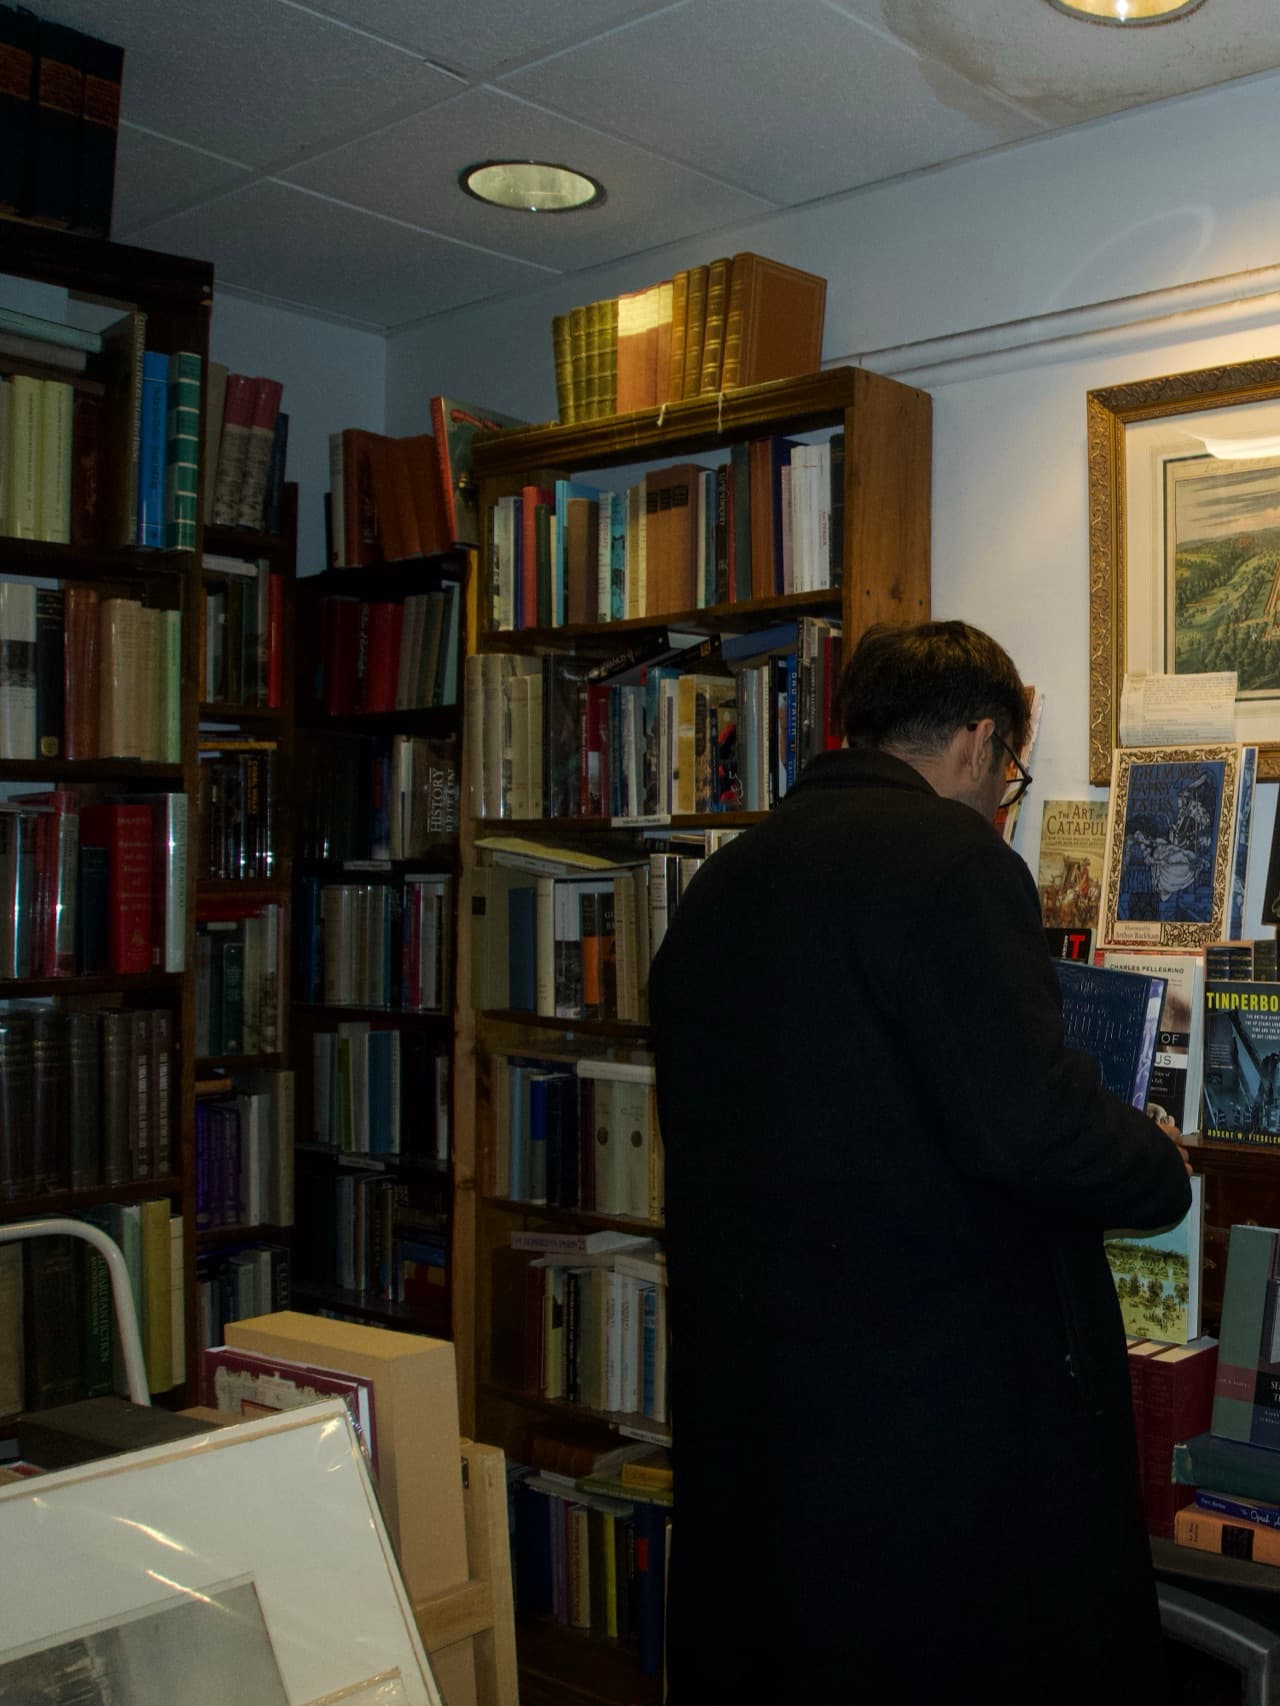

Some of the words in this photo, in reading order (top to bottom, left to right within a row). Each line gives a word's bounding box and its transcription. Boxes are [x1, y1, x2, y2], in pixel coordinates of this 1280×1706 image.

[431, 768, 444, 833] HISTORY
[1072, 805, 1094, 817] ART
[1047, 816, 1108, 835] CATAPUL
[1142, 965, 1184, 974] PELLEGRINO
[1160, 1034, 1180, 1044] OF
